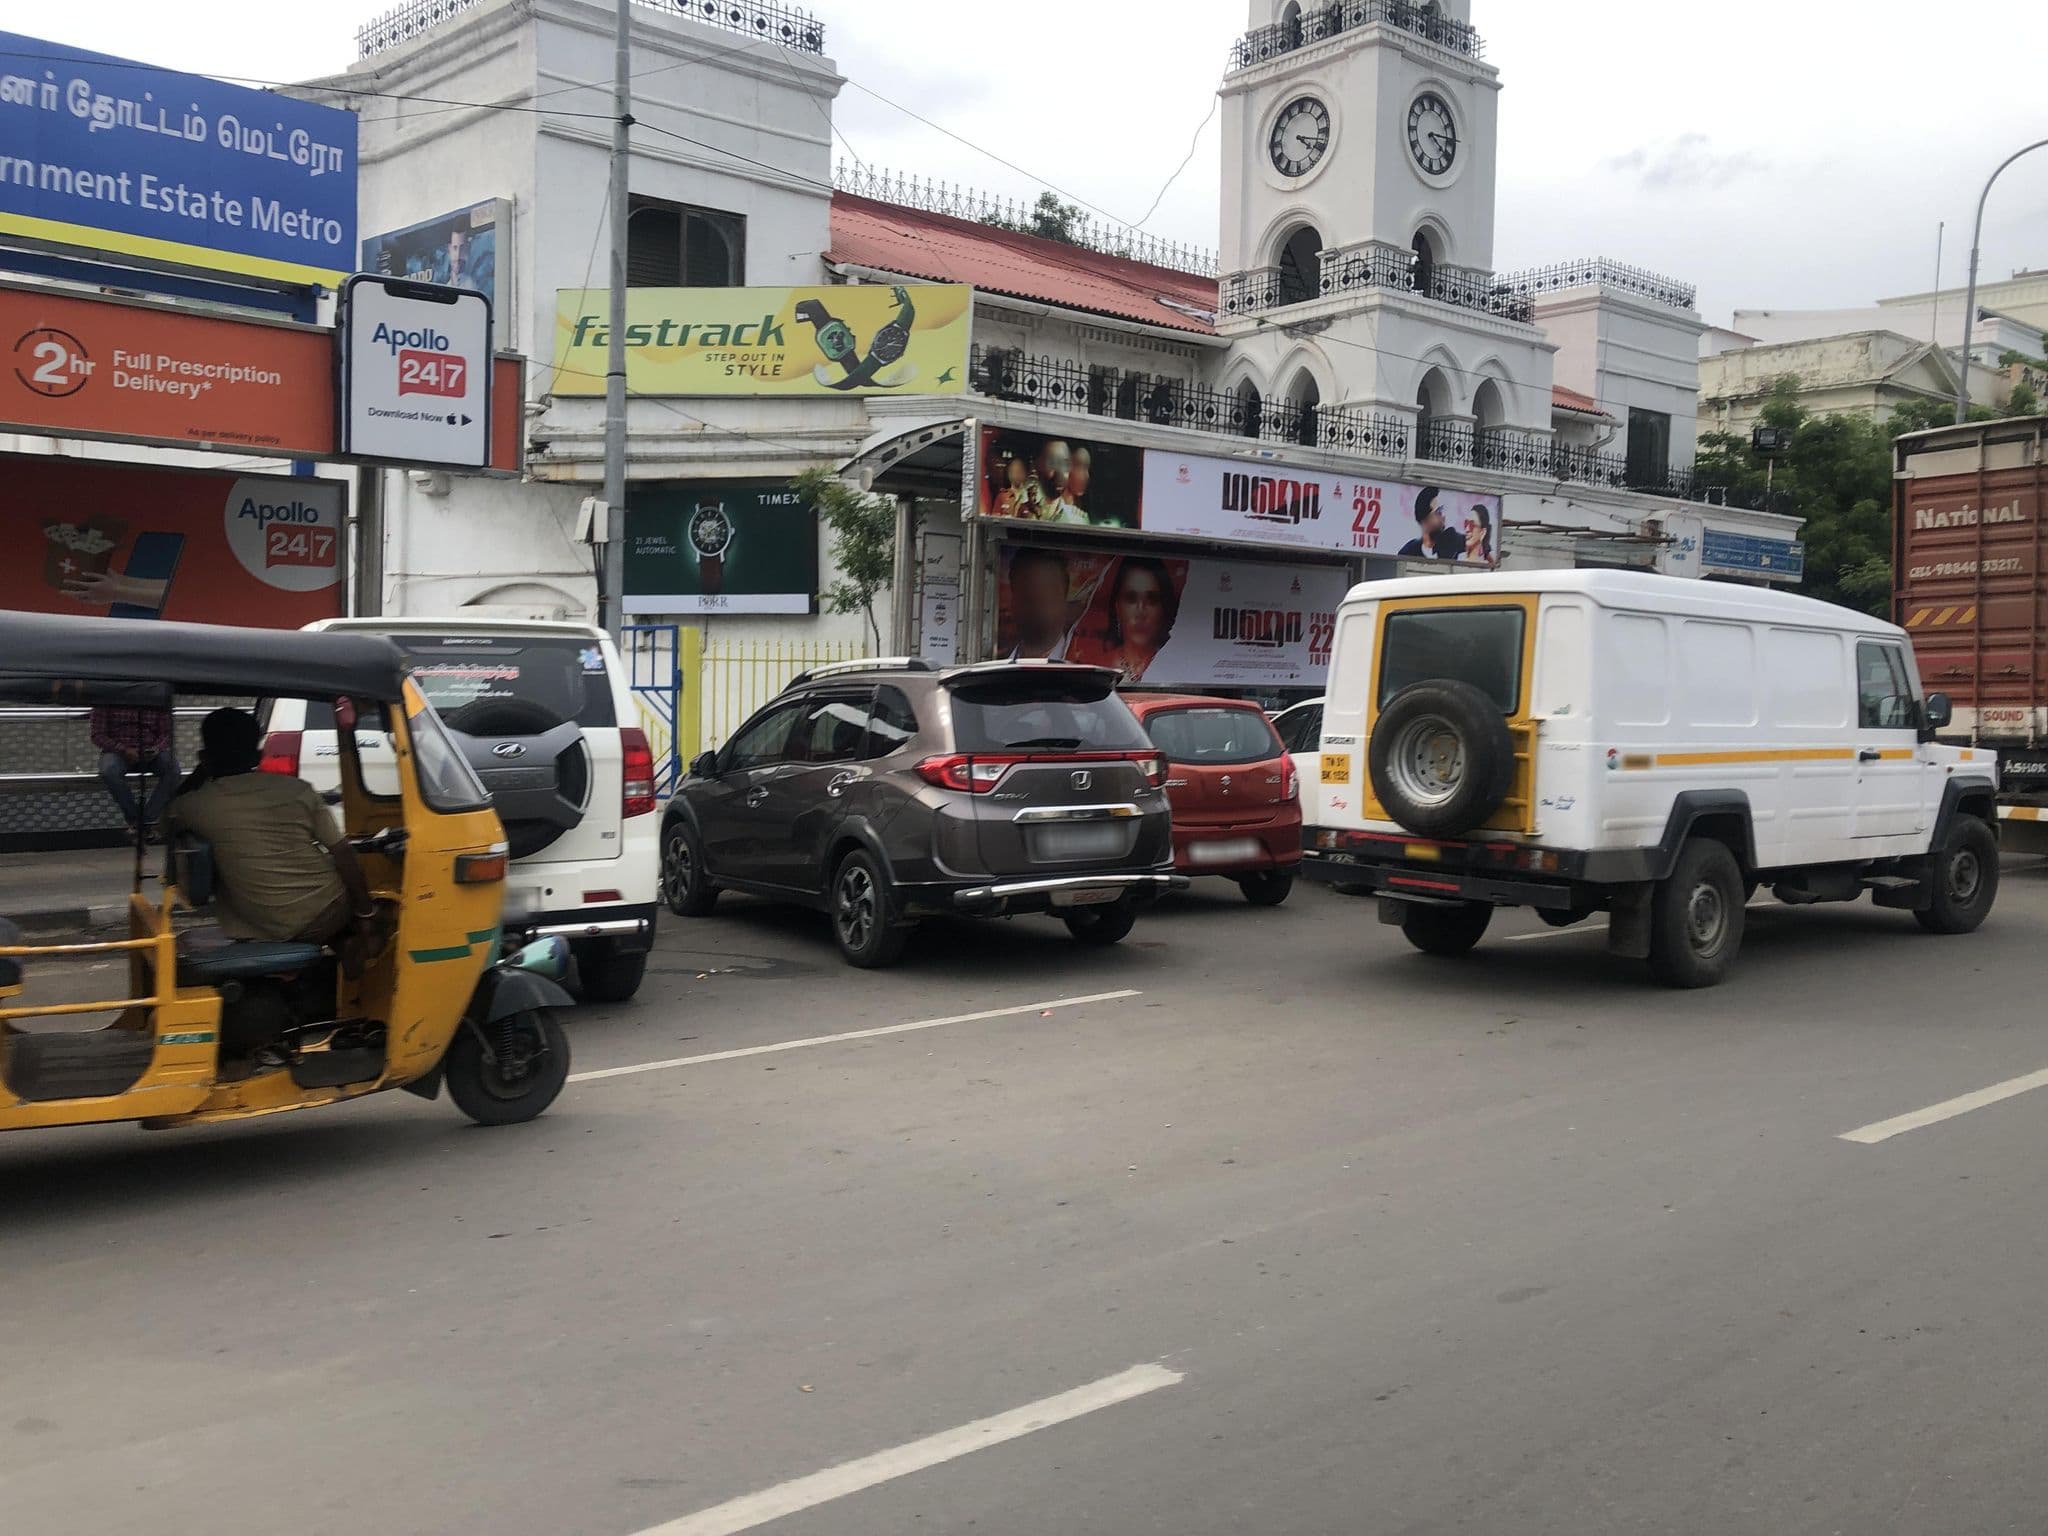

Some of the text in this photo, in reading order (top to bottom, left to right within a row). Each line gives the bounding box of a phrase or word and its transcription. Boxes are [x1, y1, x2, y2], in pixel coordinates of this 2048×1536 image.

[67, 78, 207, 142] தோட்டம்
[217, 115, 343, 177] மெட்ரோ
[140, 174, 243, 226] Estate
[251, 196, 342, 245] Metro
[572, 315, 785, 347] fastrack
[371, 322, 450, 356] Apollo
[705, 353, 785, 362] STEP OUT IN
[113, 350, 282, 385] Full Prescription
[724, 364, 782, 376] STYLE
[368, 407, 444, 422] Download Now
[1353, 484, 1382, 498] FROM
[757, 493, 801, 505] TIMEX
[237, 497, 319, 530] Apollo
[1351, 498, 1381, 534] 22
[1352, 534, 1379, 548] JULY
[635, 546, 677, 555] AUTOMATIC
[1983, 710, 2024, 721] SOUND
[2002, 760, 2047, 773] ASHOK
